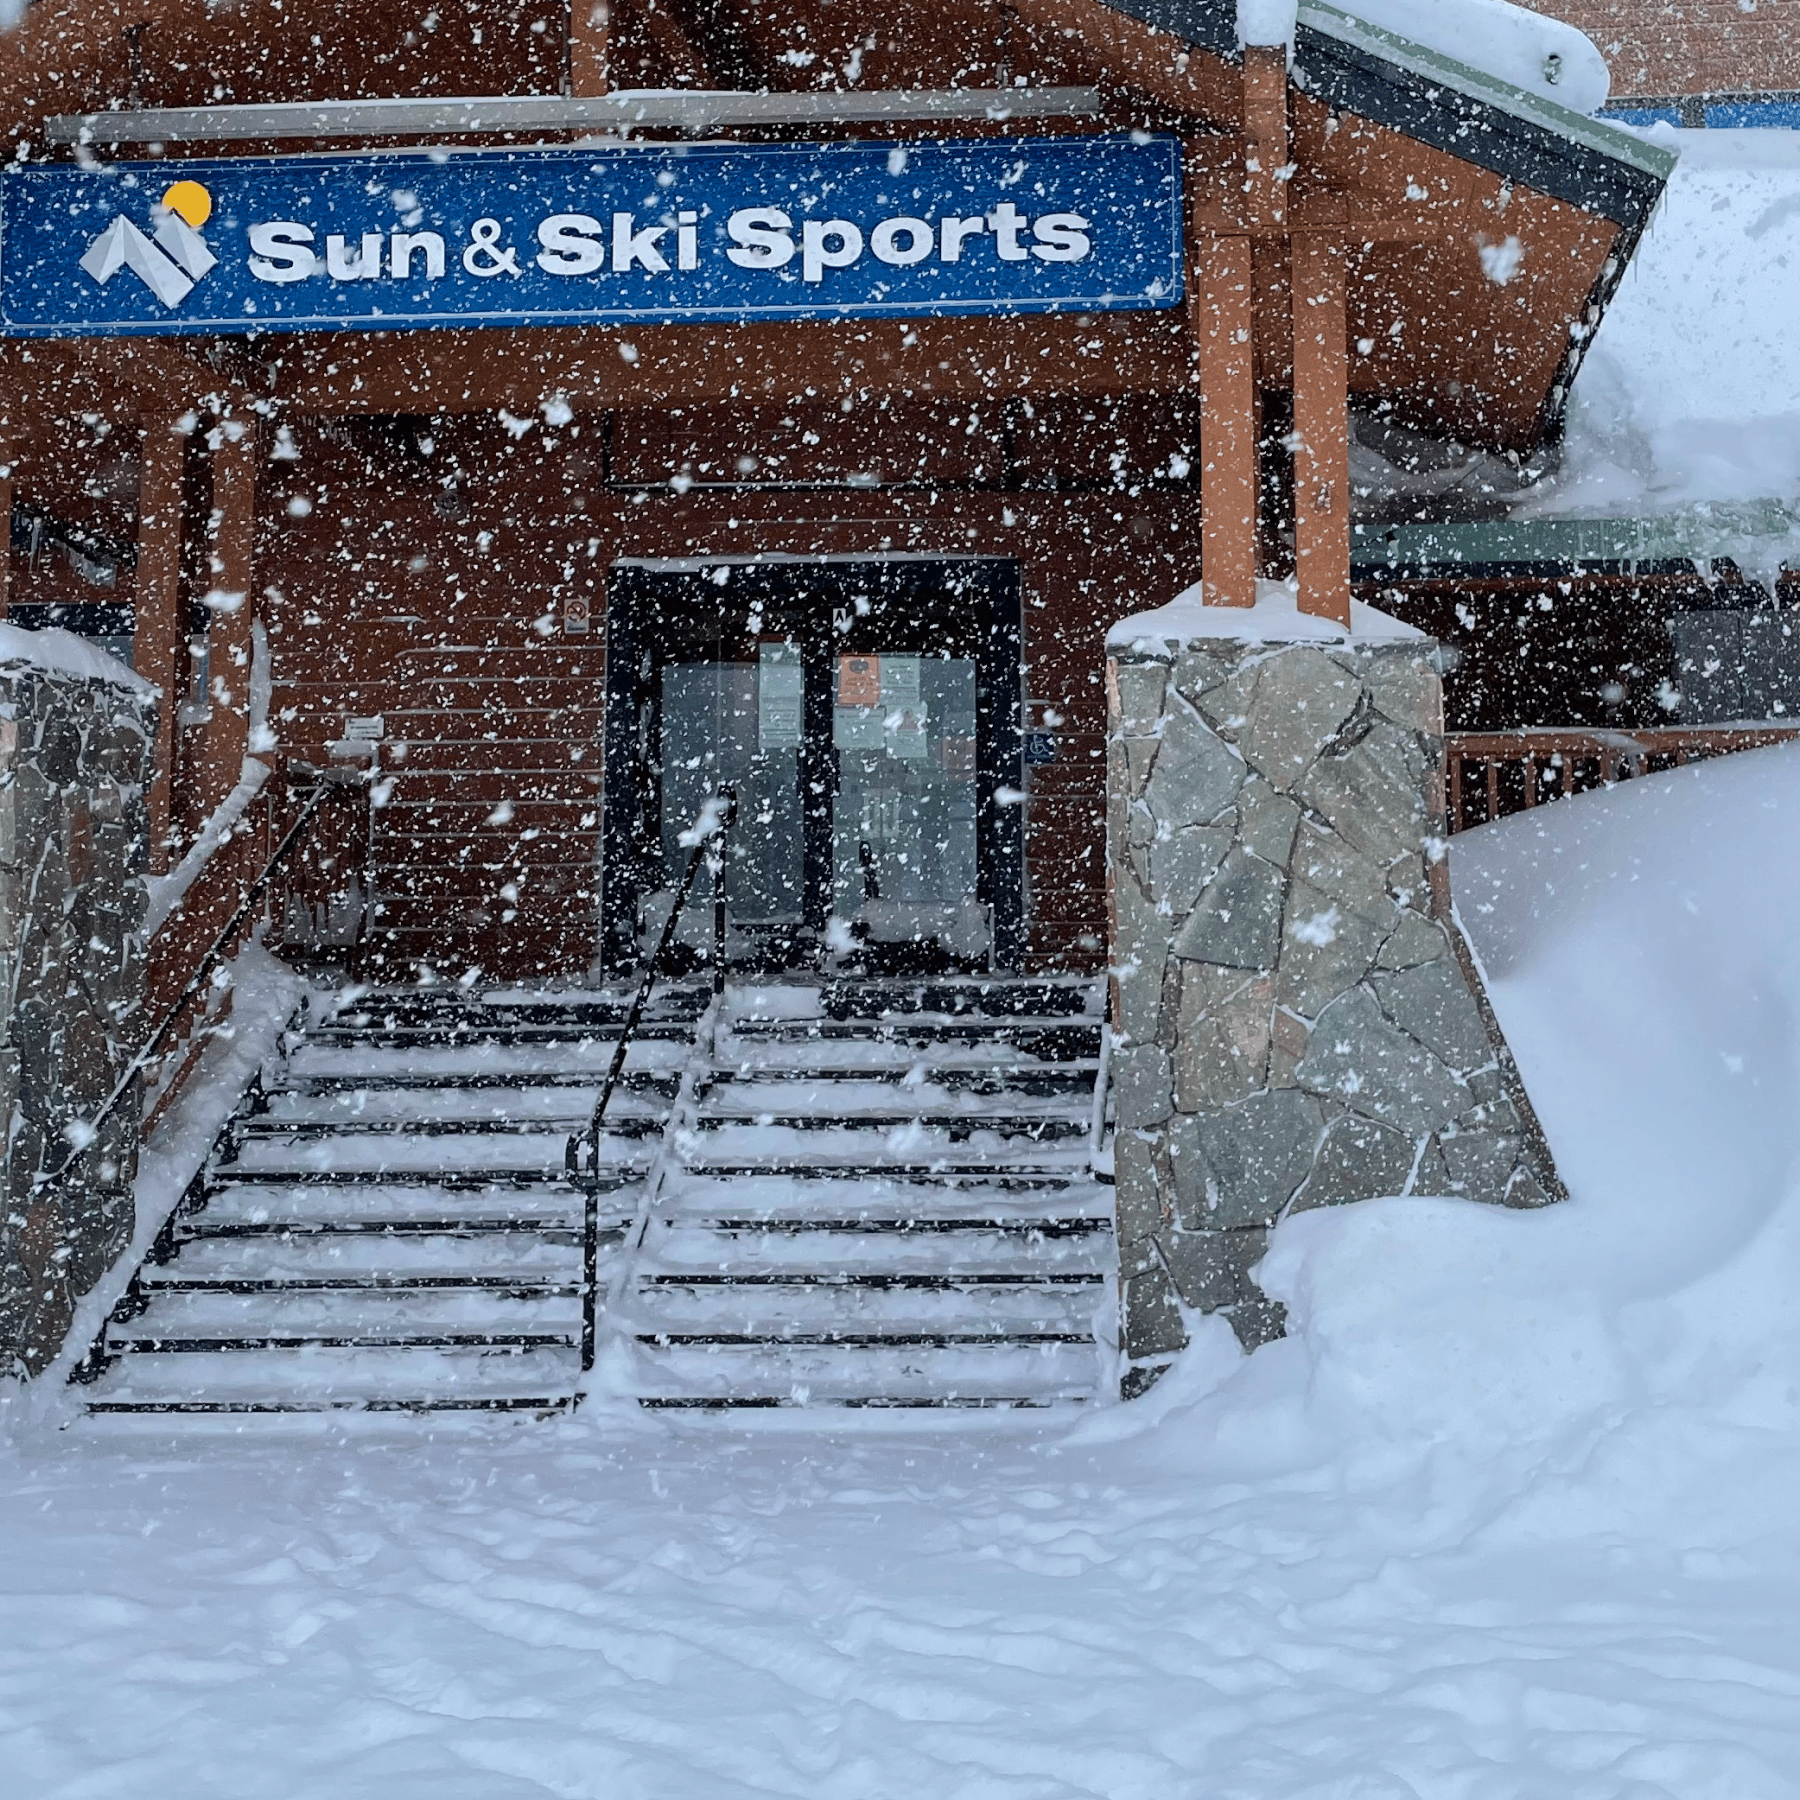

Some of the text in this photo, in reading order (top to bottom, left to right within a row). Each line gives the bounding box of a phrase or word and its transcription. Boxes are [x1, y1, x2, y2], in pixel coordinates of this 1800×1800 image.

[249, 203, 1091, 283] Sun & Ski Sports
